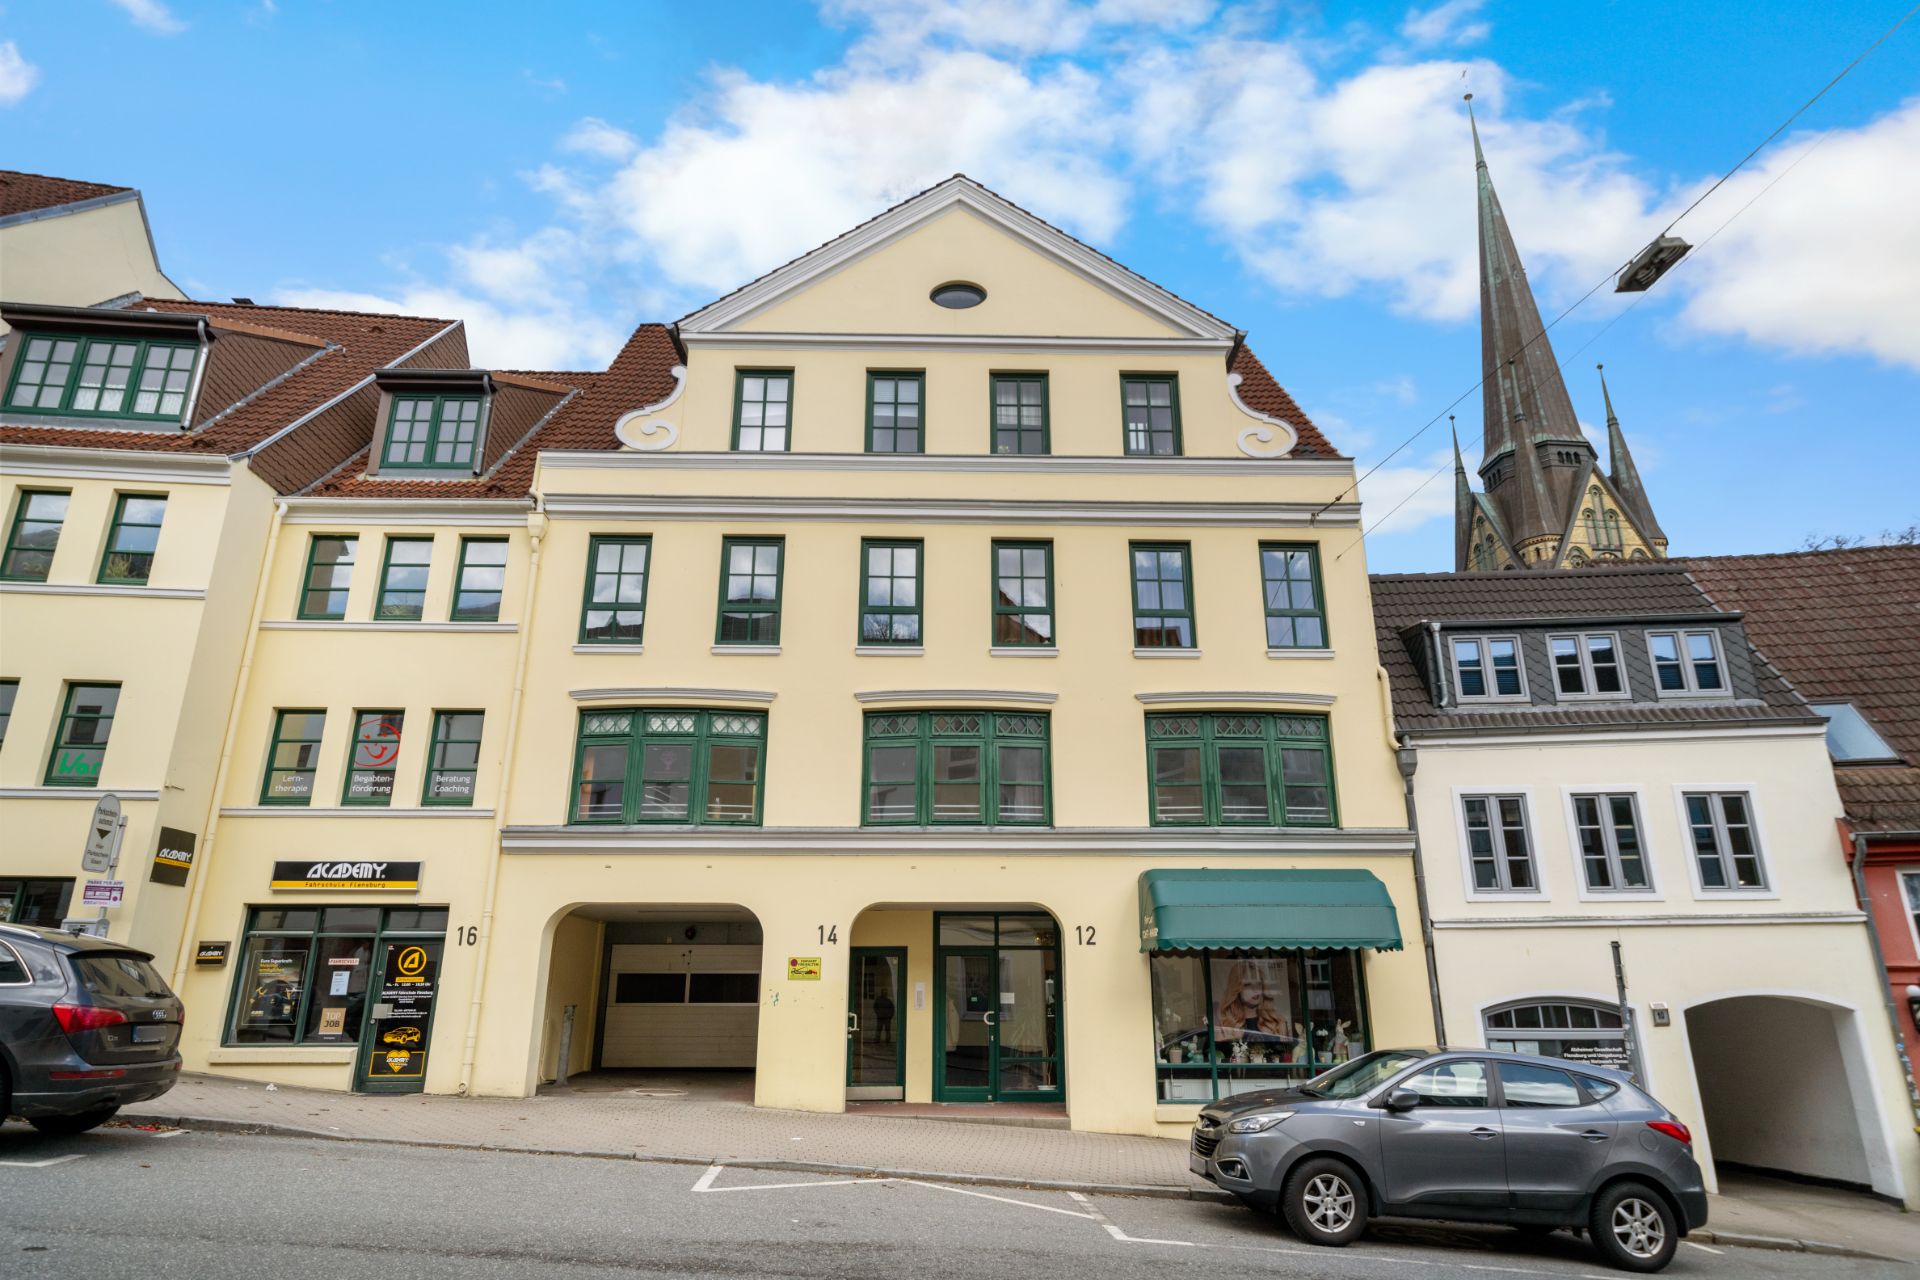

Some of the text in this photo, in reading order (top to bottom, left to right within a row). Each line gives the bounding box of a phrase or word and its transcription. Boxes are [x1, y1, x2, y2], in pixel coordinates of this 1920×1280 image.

[354, 774, 393, 784] Begabten-
[436, 774, 471, 784] Beratung
[275, 784, 308, 793] therapie
[352, 784, 391, 794] förderung
[434, 785, 470, 794] Coaching
[457, 925, 478, 947] 16
[818, 924, 838, 945] 14
[1075, 925, 1097, 946] 12
[326, 1011, 342, 1020] TOP
[323, 1020, 341, 1028] JOB
